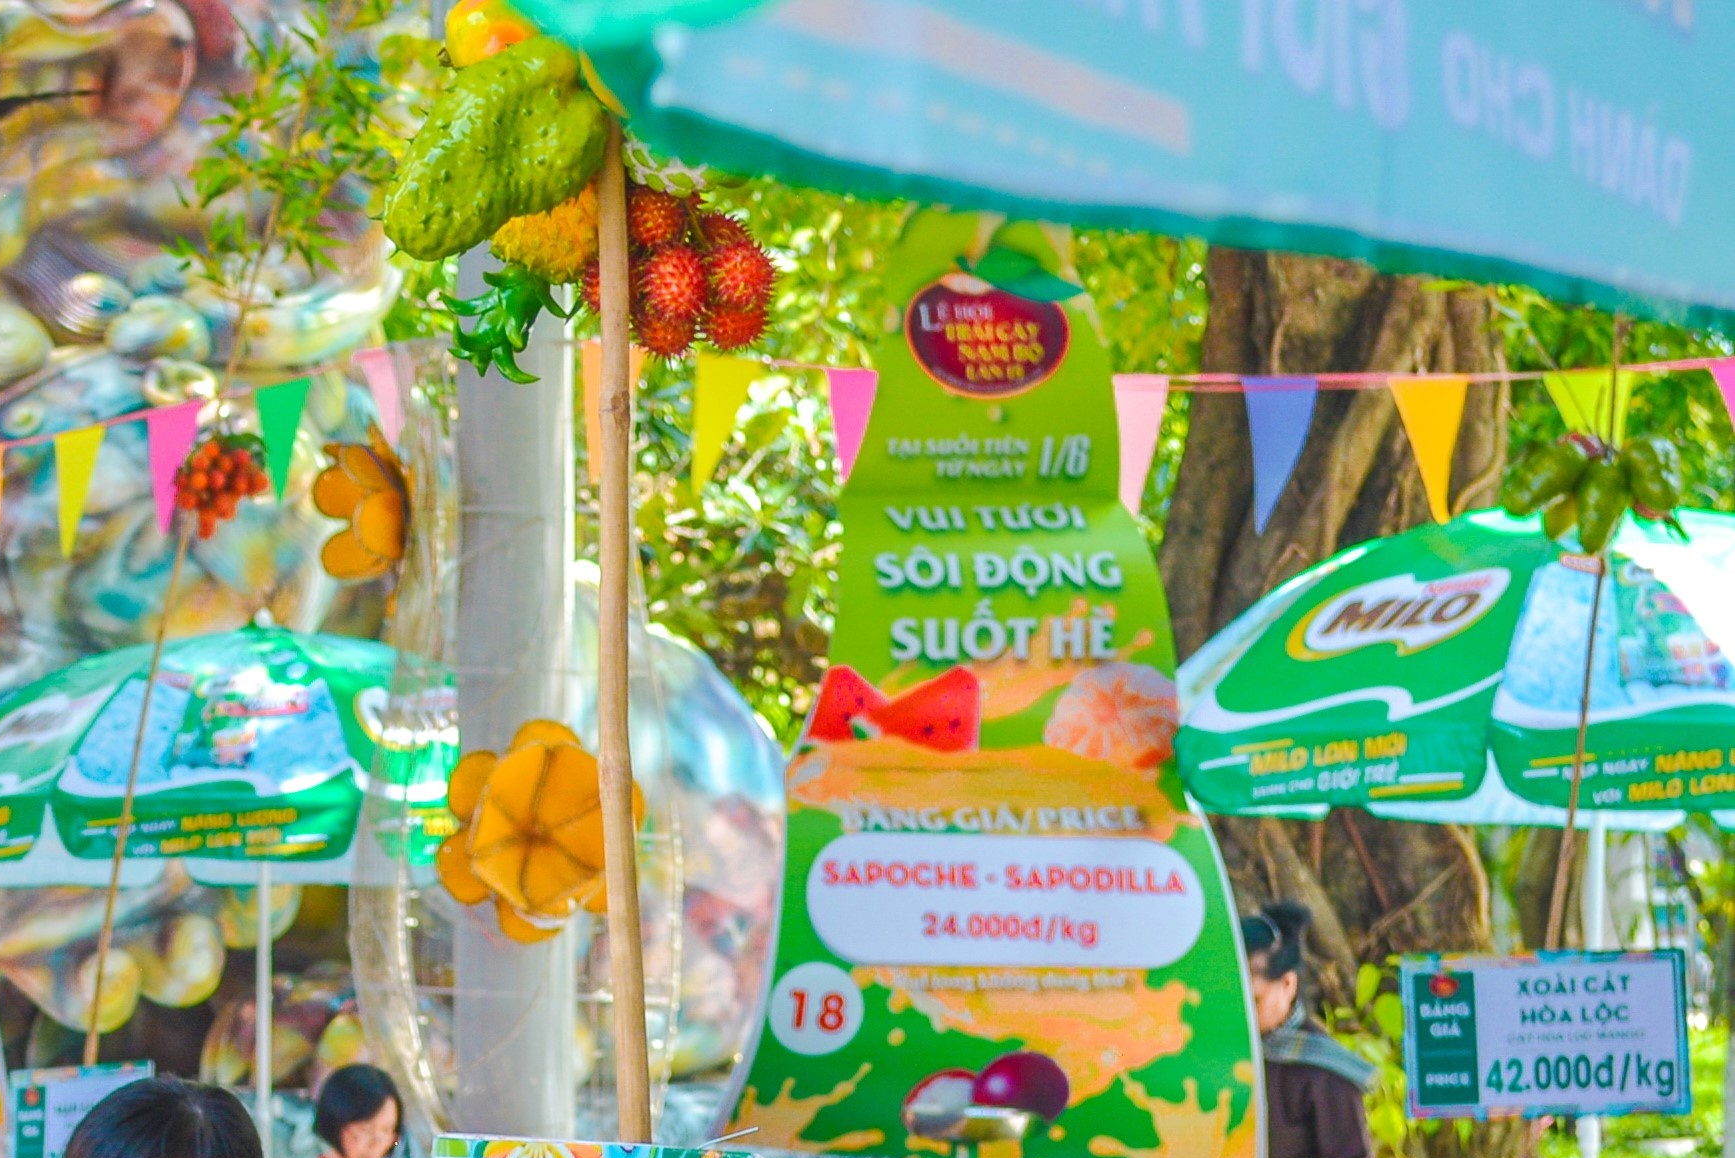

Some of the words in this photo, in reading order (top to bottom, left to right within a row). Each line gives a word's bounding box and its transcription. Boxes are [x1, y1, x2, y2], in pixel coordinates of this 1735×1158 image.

[1038, 434, 1092, 478] 1/6
[885, 506, 966, 531] VUI
[874, 544, 963, 589] SÔI
[972, 544, 1123, 597] ĐỘNG
[890, 598, 1038, 662] SUỐT
[1049, 605, 1117, 661] HÈ
[1318, 592, 1481, 637] MILO
[822, 860, 979, 889] SAPOCHE
[1004, 864, 1186, 895] SAPODILLA
[789, 990, 847, 1033] 18
[1485, 1051, 1676, 1098] 42.000đ/kg
